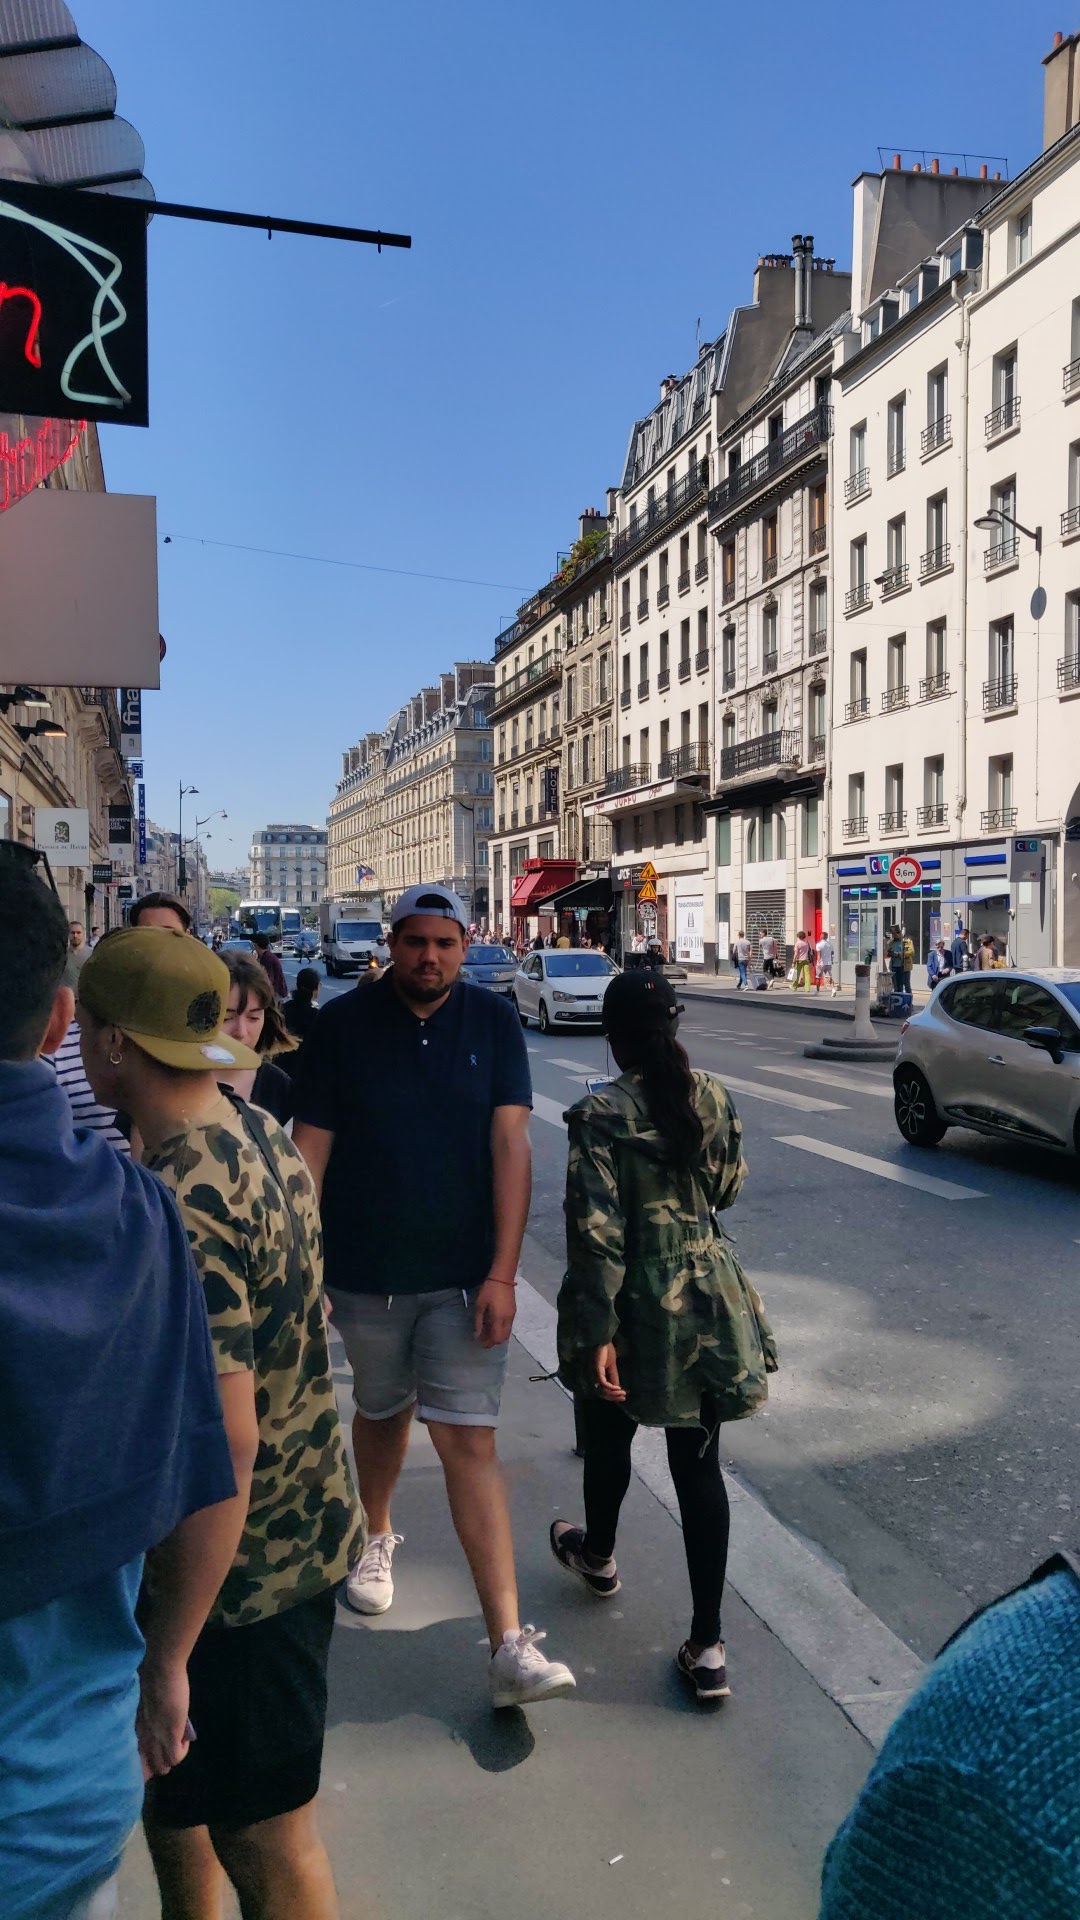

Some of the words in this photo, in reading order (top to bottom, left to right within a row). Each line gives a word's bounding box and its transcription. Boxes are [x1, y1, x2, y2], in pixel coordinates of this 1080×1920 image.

[1017, 842, 1036, 850] CIC
[871, 859, 889, 872] CIC
[895, 868, 916, 878] 3,6m
